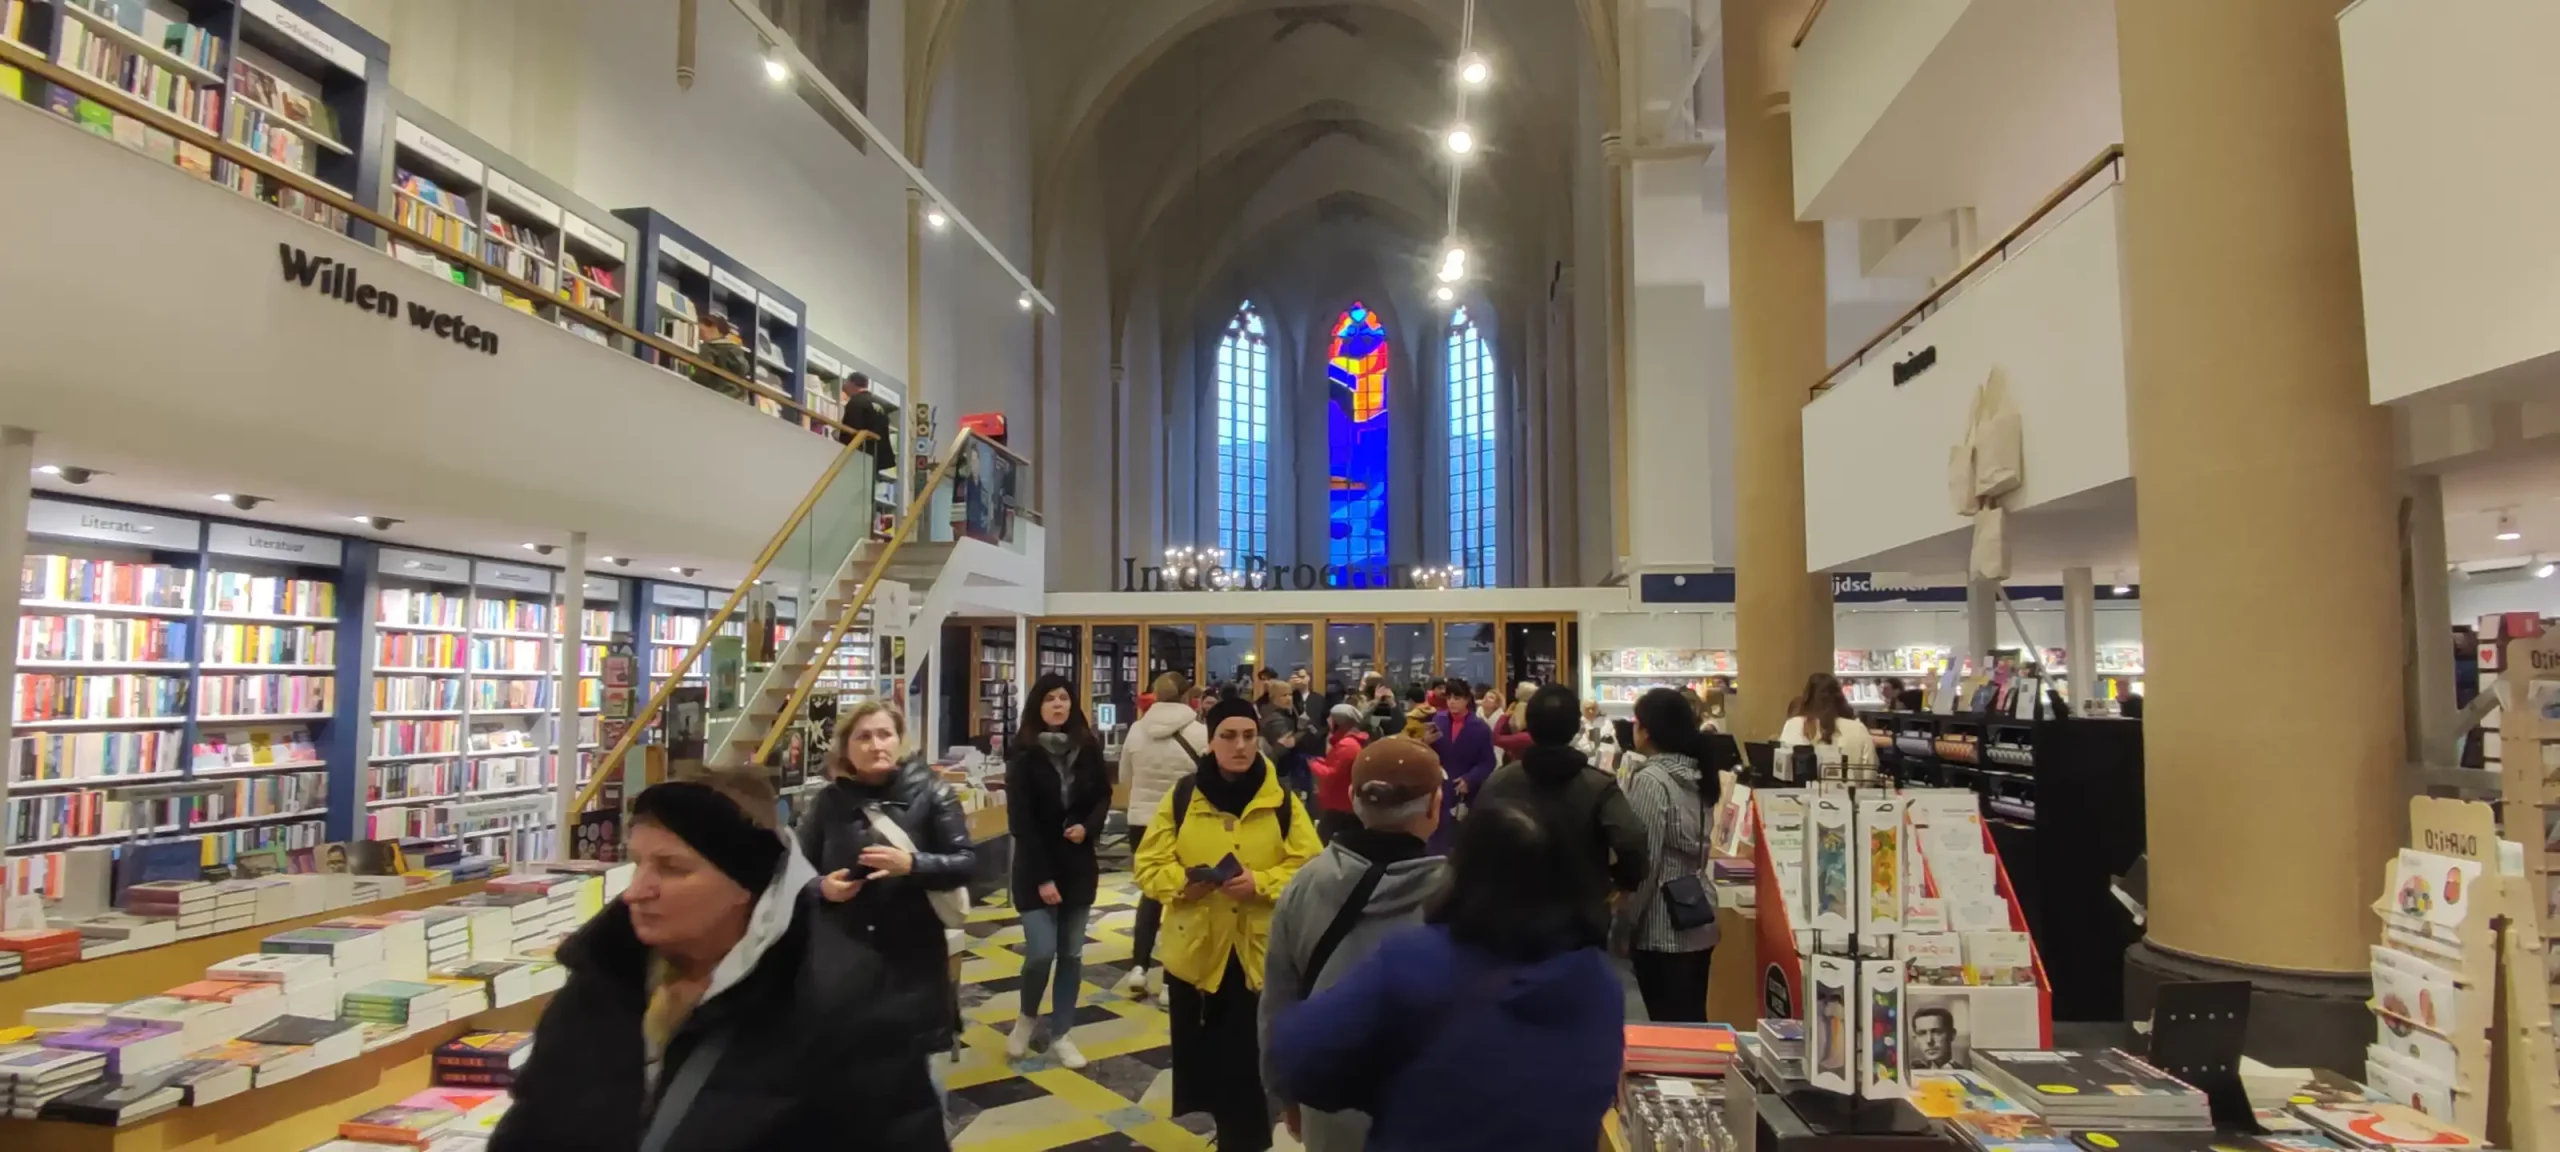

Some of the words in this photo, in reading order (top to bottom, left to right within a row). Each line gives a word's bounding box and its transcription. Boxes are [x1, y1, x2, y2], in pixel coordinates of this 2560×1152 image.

[279, 242, 399, 318] Willen
[407, 301, 500, 355] weten
[248, 535, 305, 553] Literatuur
[1123, 556, 1163, 592] In
